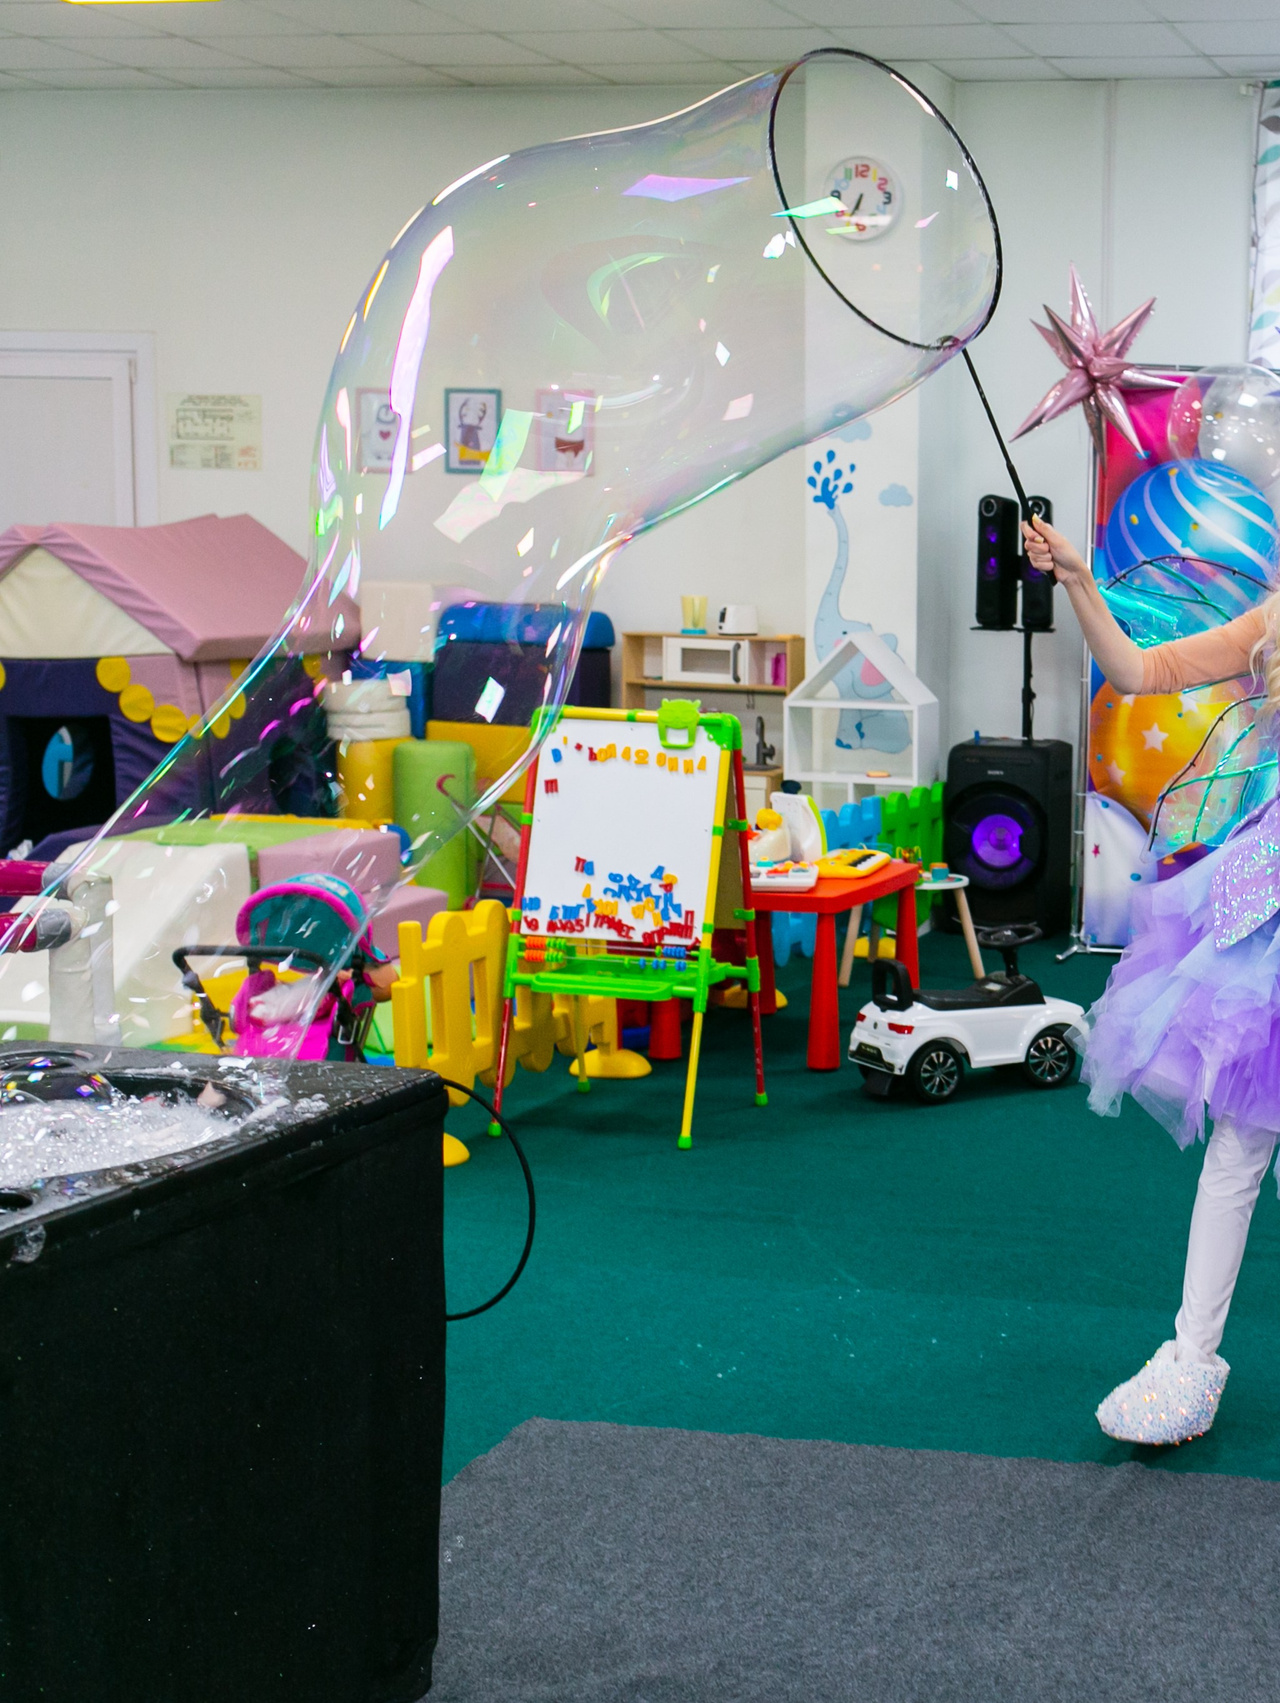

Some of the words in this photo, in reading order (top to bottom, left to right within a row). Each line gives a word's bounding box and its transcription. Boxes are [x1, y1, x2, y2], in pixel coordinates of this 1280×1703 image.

[854, 164, 870, 178] 12
[877, 177, 888, 192] 2
[883, 191, 892, 205] 3
